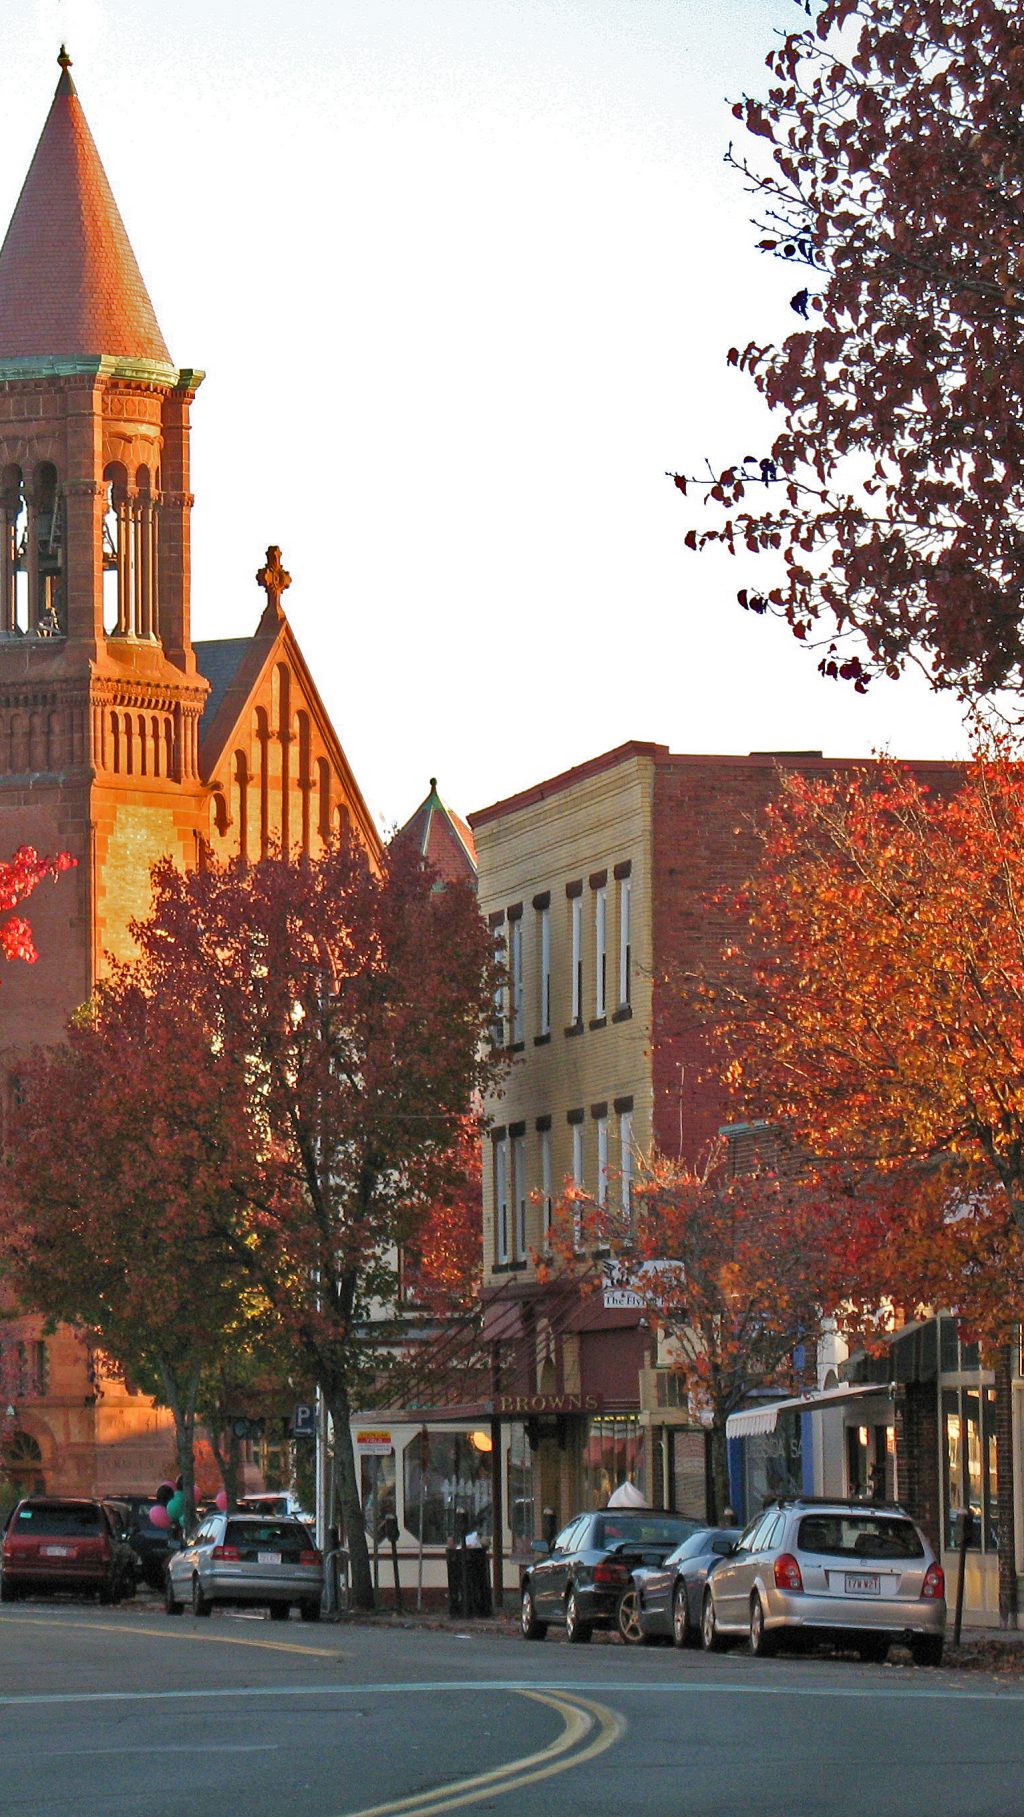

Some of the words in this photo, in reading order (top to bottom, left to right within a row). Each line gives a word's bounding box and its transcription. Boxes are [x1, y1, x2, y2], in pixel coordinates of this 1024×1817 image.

[606, 1296, 624, 1306] The
[500, 1395, 598, 1411] BROWNS
[297, 1407, 311, 1427] P
